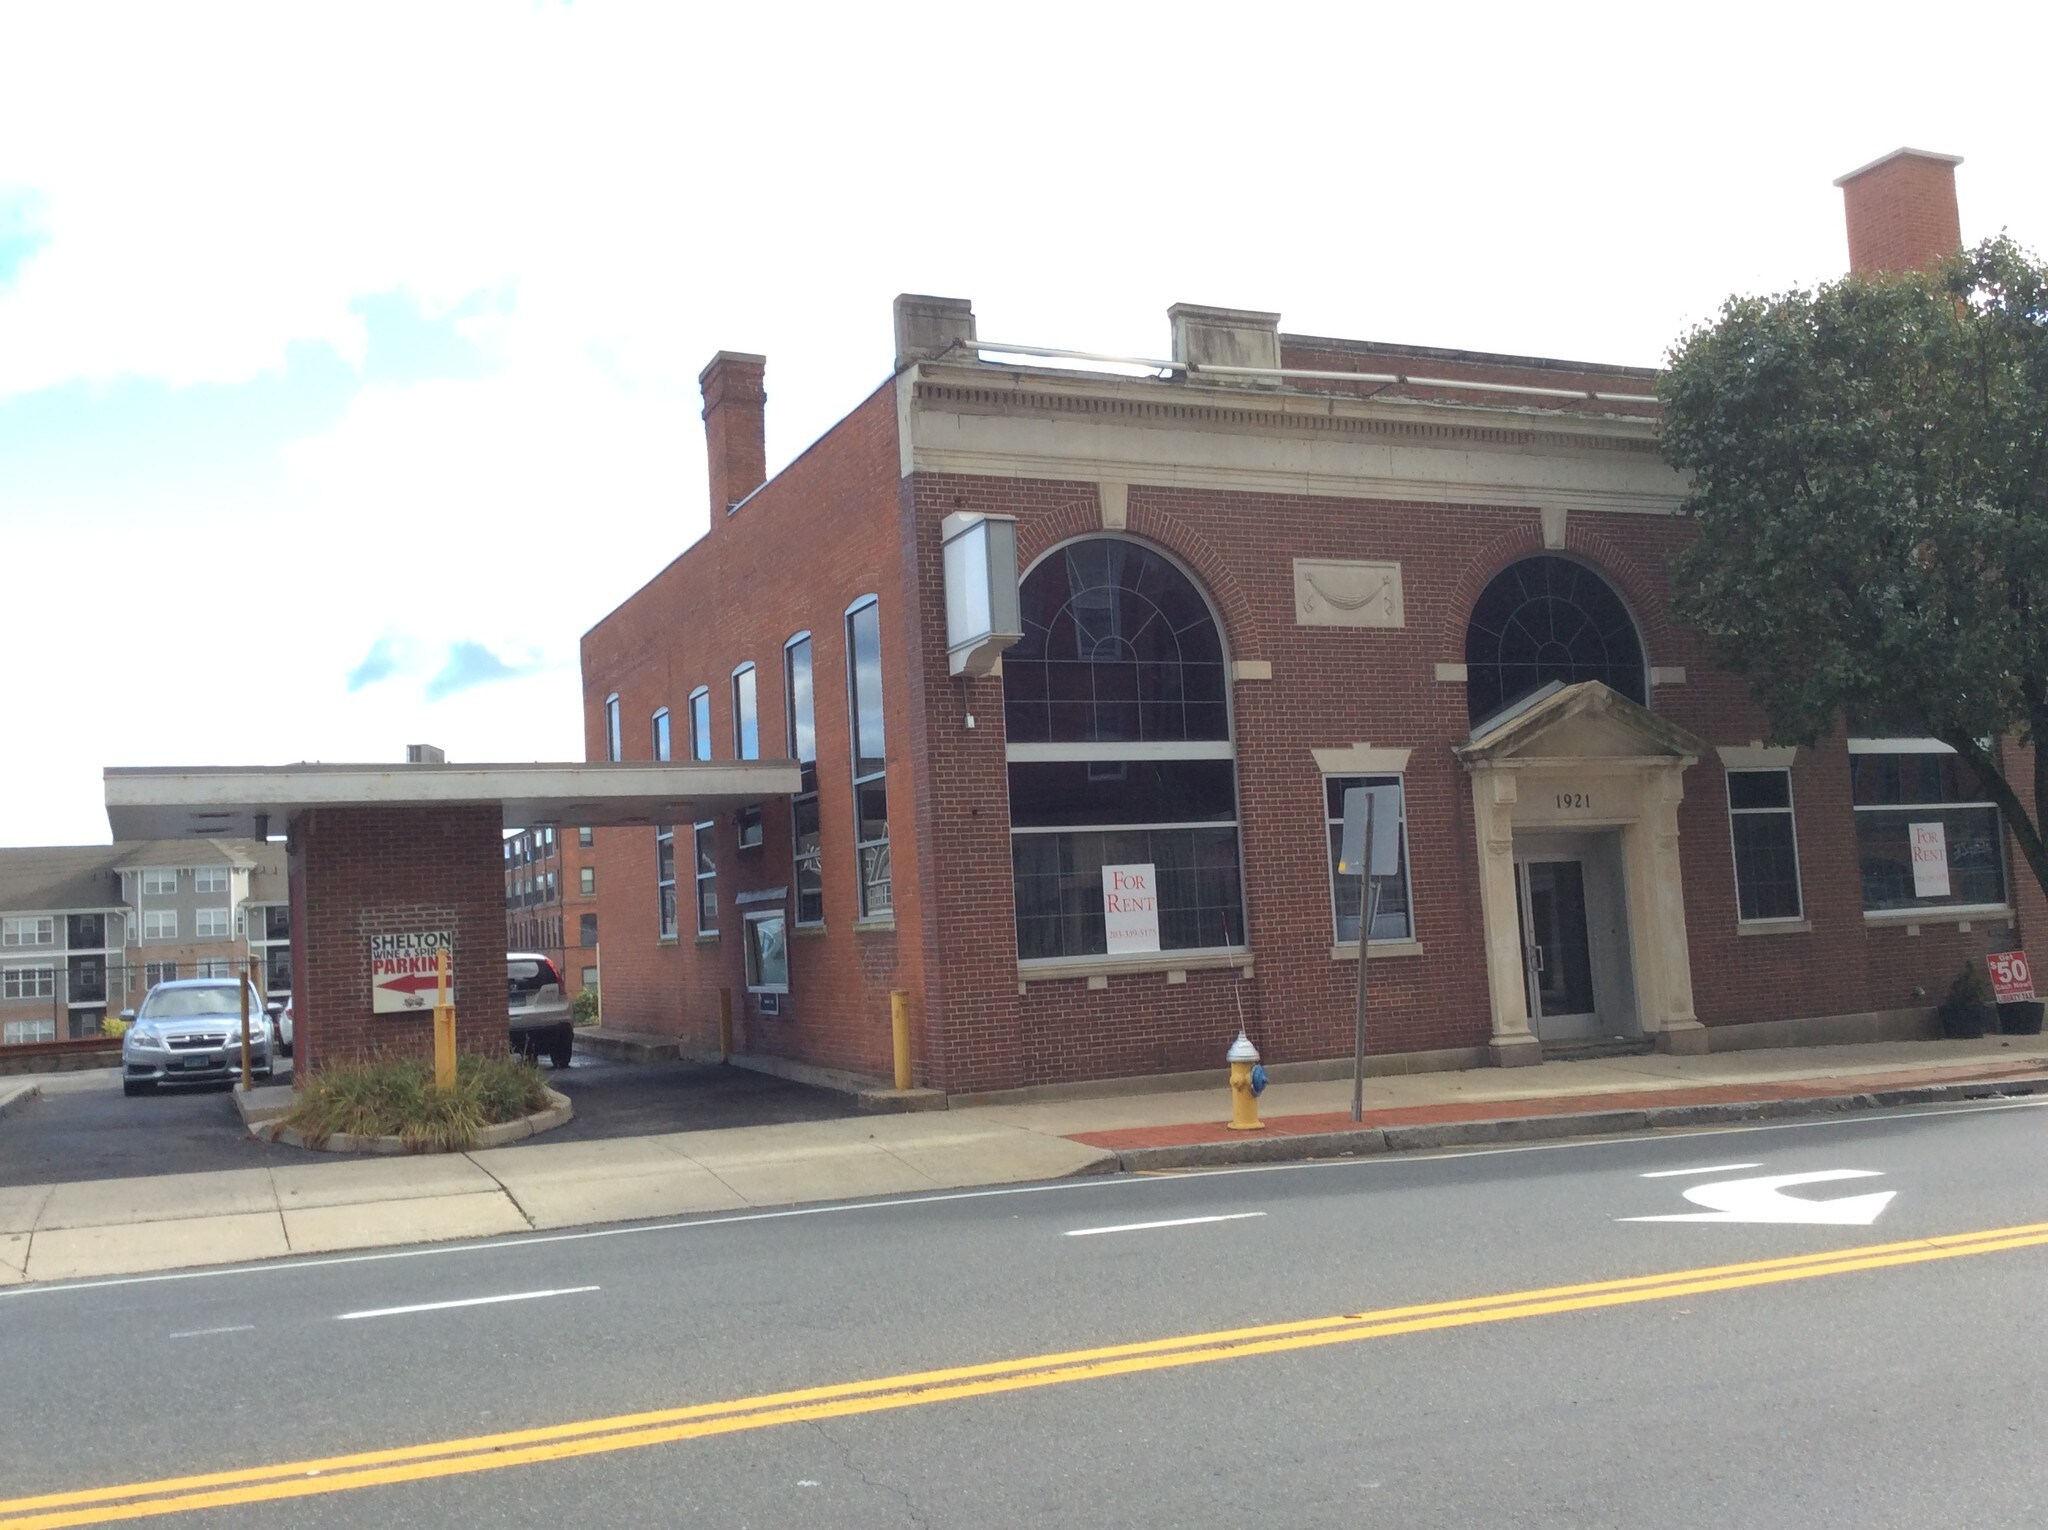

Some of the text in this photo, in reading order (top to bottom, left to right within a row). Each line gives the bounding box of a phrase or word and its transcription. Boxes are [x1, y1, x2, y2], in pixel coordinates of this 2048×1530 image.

[1556, 793, 1590, 809] 1921
[1916, 828, 1938, 844] FOR
[1913, 846, 1944, 861] RENT
[1113, 870, 1146, 890] FOR
[1106, 893, 1155, 913] RENT
[372, 932, 451, 951] SHELTON
[373, 948, 400, 960] WINE
[403, 948, 411, 958] &
